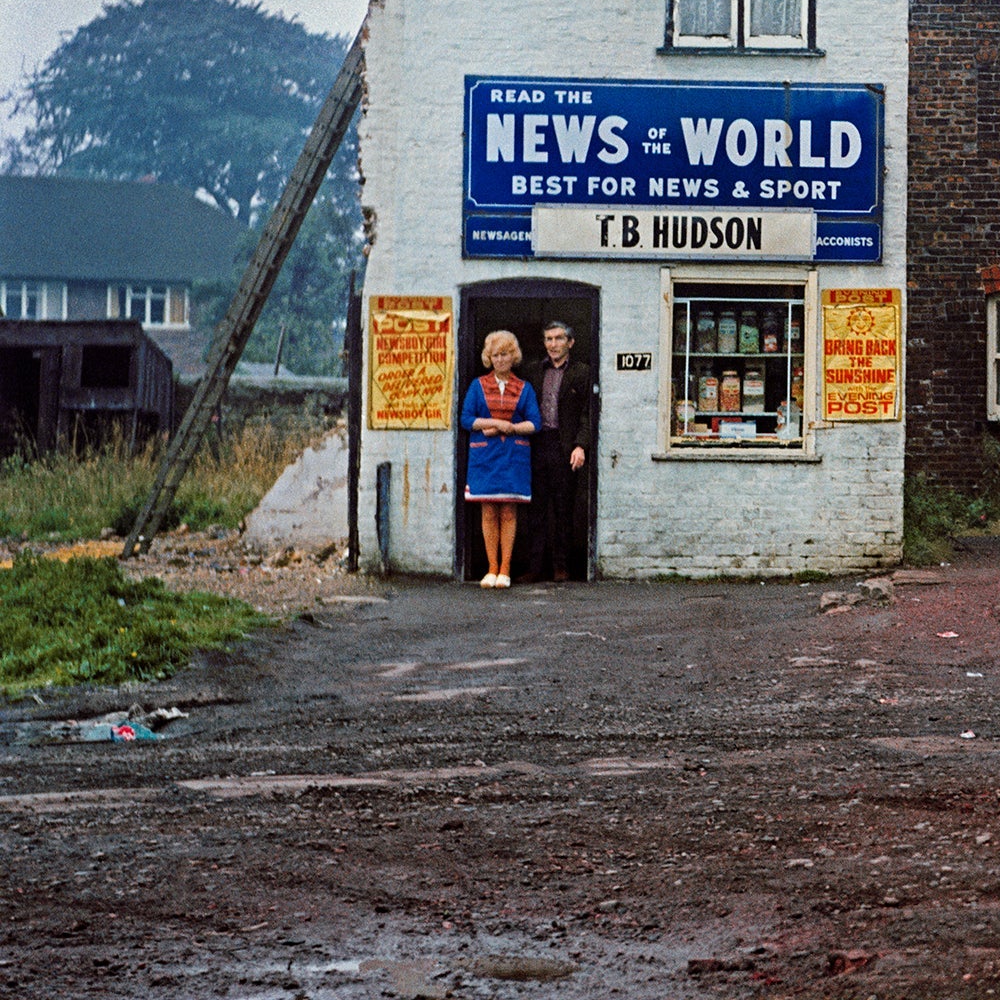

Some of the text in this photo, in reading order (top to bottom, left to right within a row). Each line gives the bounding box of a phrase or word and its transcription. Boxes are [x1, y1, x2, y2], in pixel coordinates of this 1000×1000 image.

[490, 89, 593, 104] READ THE
[648, 127, 667, 140] OF
[486, 113, 862, 169] NEWS WORLD
[642, 142, 672, 155] THE
[511, 176, 841, 200] BEST FOR NEWS & SPORT
[653, 216, 762, 250] HUDSON
[816, 236, 873, 247] ACCONISTS
[824, 339, 896, 355] BRING BACK
[378, 351, 446, 365] COMPETITION
[621, 355, 651, 367] 1077
[848, 357, 872, 368] THE
[378, 367, 426, 382] ORDER A
[825, 369, 895, 384] SUNSHINE
[827, 392, 893, 401] EVENING
[377, 409, 424, 419] NEWSBOY
[827, 401, 893, 414] POST
